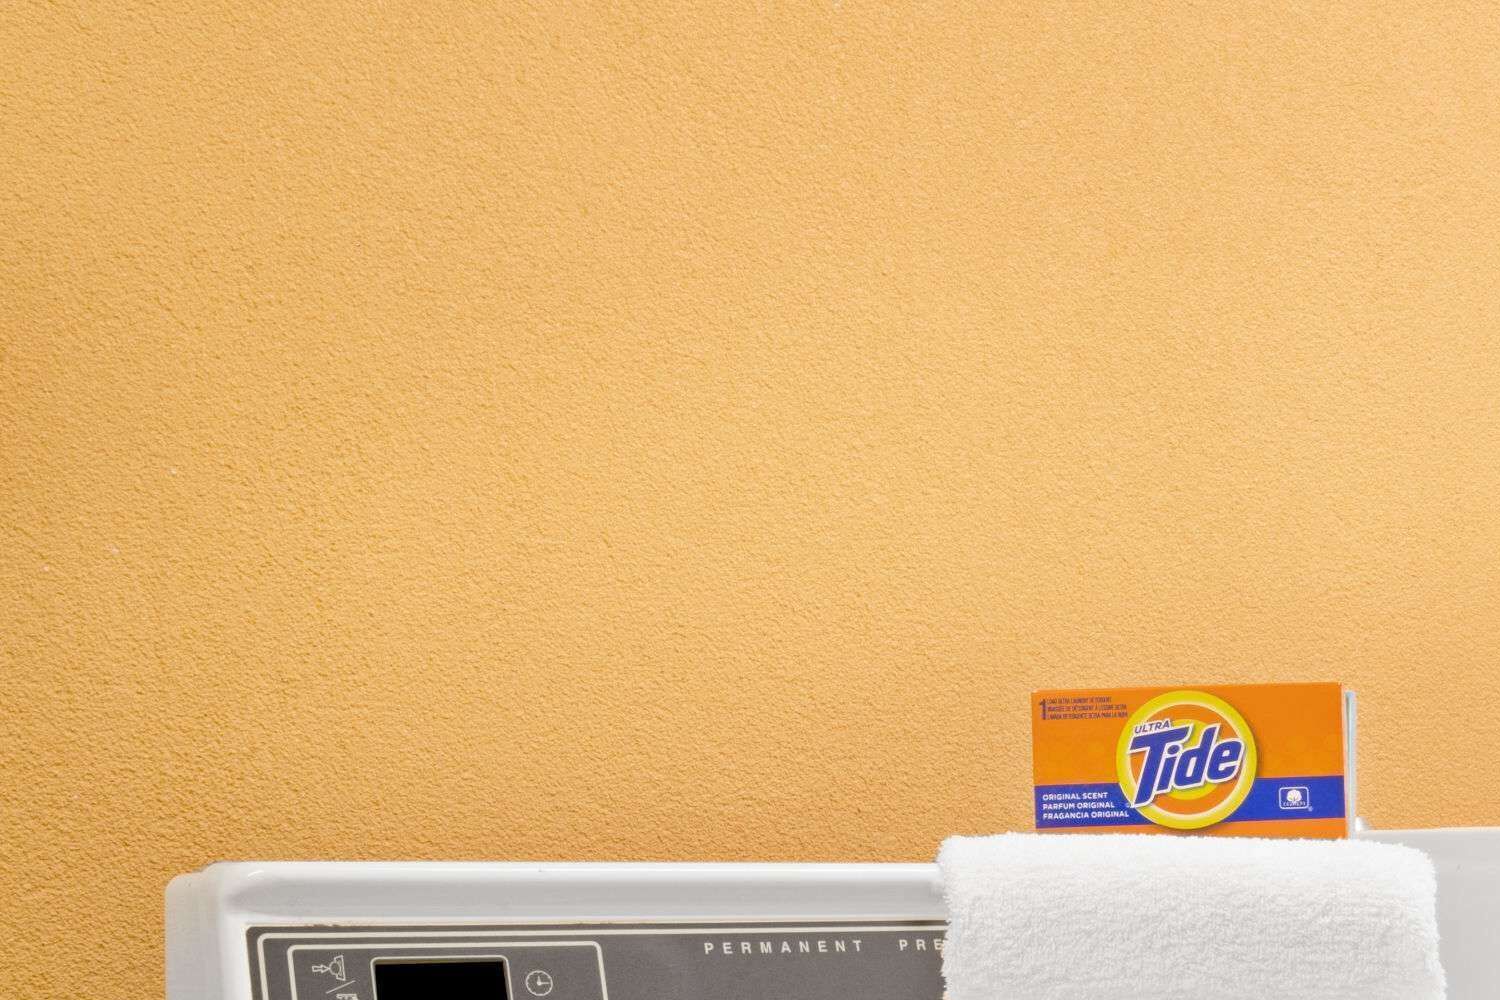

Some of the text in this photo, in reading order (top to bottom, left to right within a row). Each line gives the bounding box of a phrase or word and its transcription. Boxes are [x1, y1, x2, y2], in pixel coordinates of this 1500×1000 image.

[1039, 699, 1047, 720] 1
[1134, 719, 1171, 734] ULTRA
[1128, 724, 1244, 806] Tide
[1042, 792, 1108, 801] ORIGINAL SCENT
[1042, 801, 1115, 810] PARFUM ORIGINAL
[1042, 812, 1089, 820] FRAGANCIA
[703, 940, 863, 955] PERMANENT
